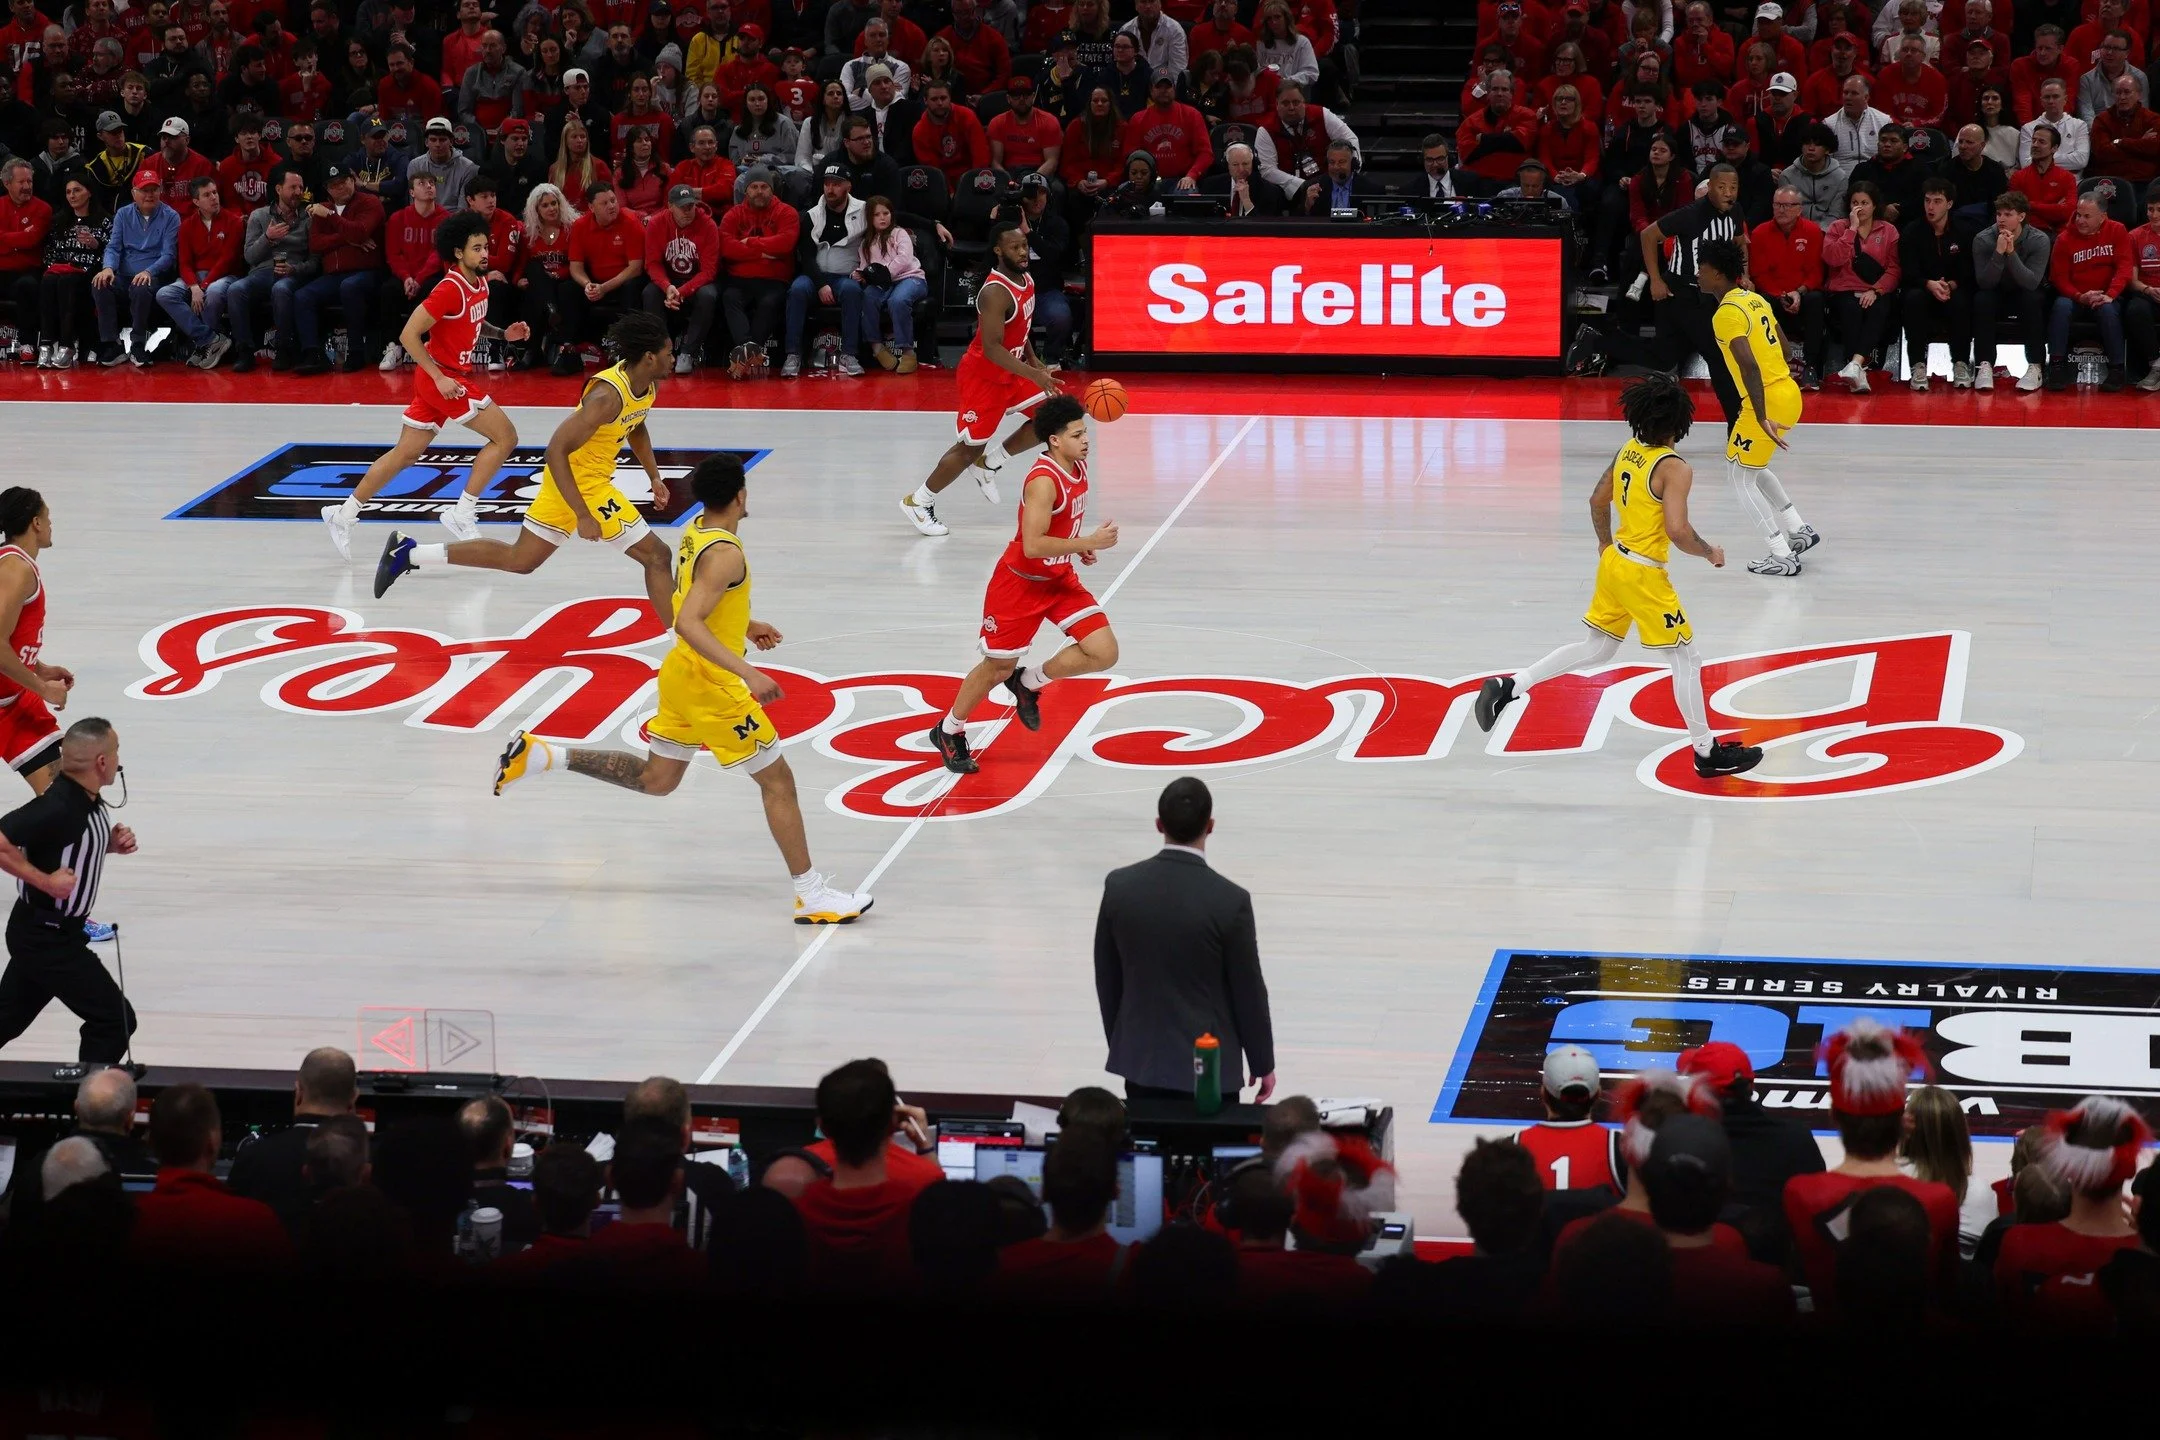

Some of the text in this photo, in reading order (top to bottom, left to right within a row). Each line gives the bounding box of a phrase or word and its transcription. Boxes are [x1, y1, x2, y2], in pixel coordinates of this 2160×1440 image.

[791, 88, 803, 105] 3
[371, 118, 382, 126] M
[2073, 244, 2114, 264] OHIO STATE
[1147, 263, 1506, 328] Safelite
[1761, 315, 1777, 345] 2
[1733, 433, 1753, 452] M
[1622, 450, 1648, 469] CADEAU
[1621, 471, 1632, 507] 3
[597, 497, 622, 521] M
[1664, 609, 1686, 629] M
[733, 714, 761, 741] M
[1686, 976, 2059, 1000] RIVALRY SERIES
[1550, 1155, 1570, 1190] 1
